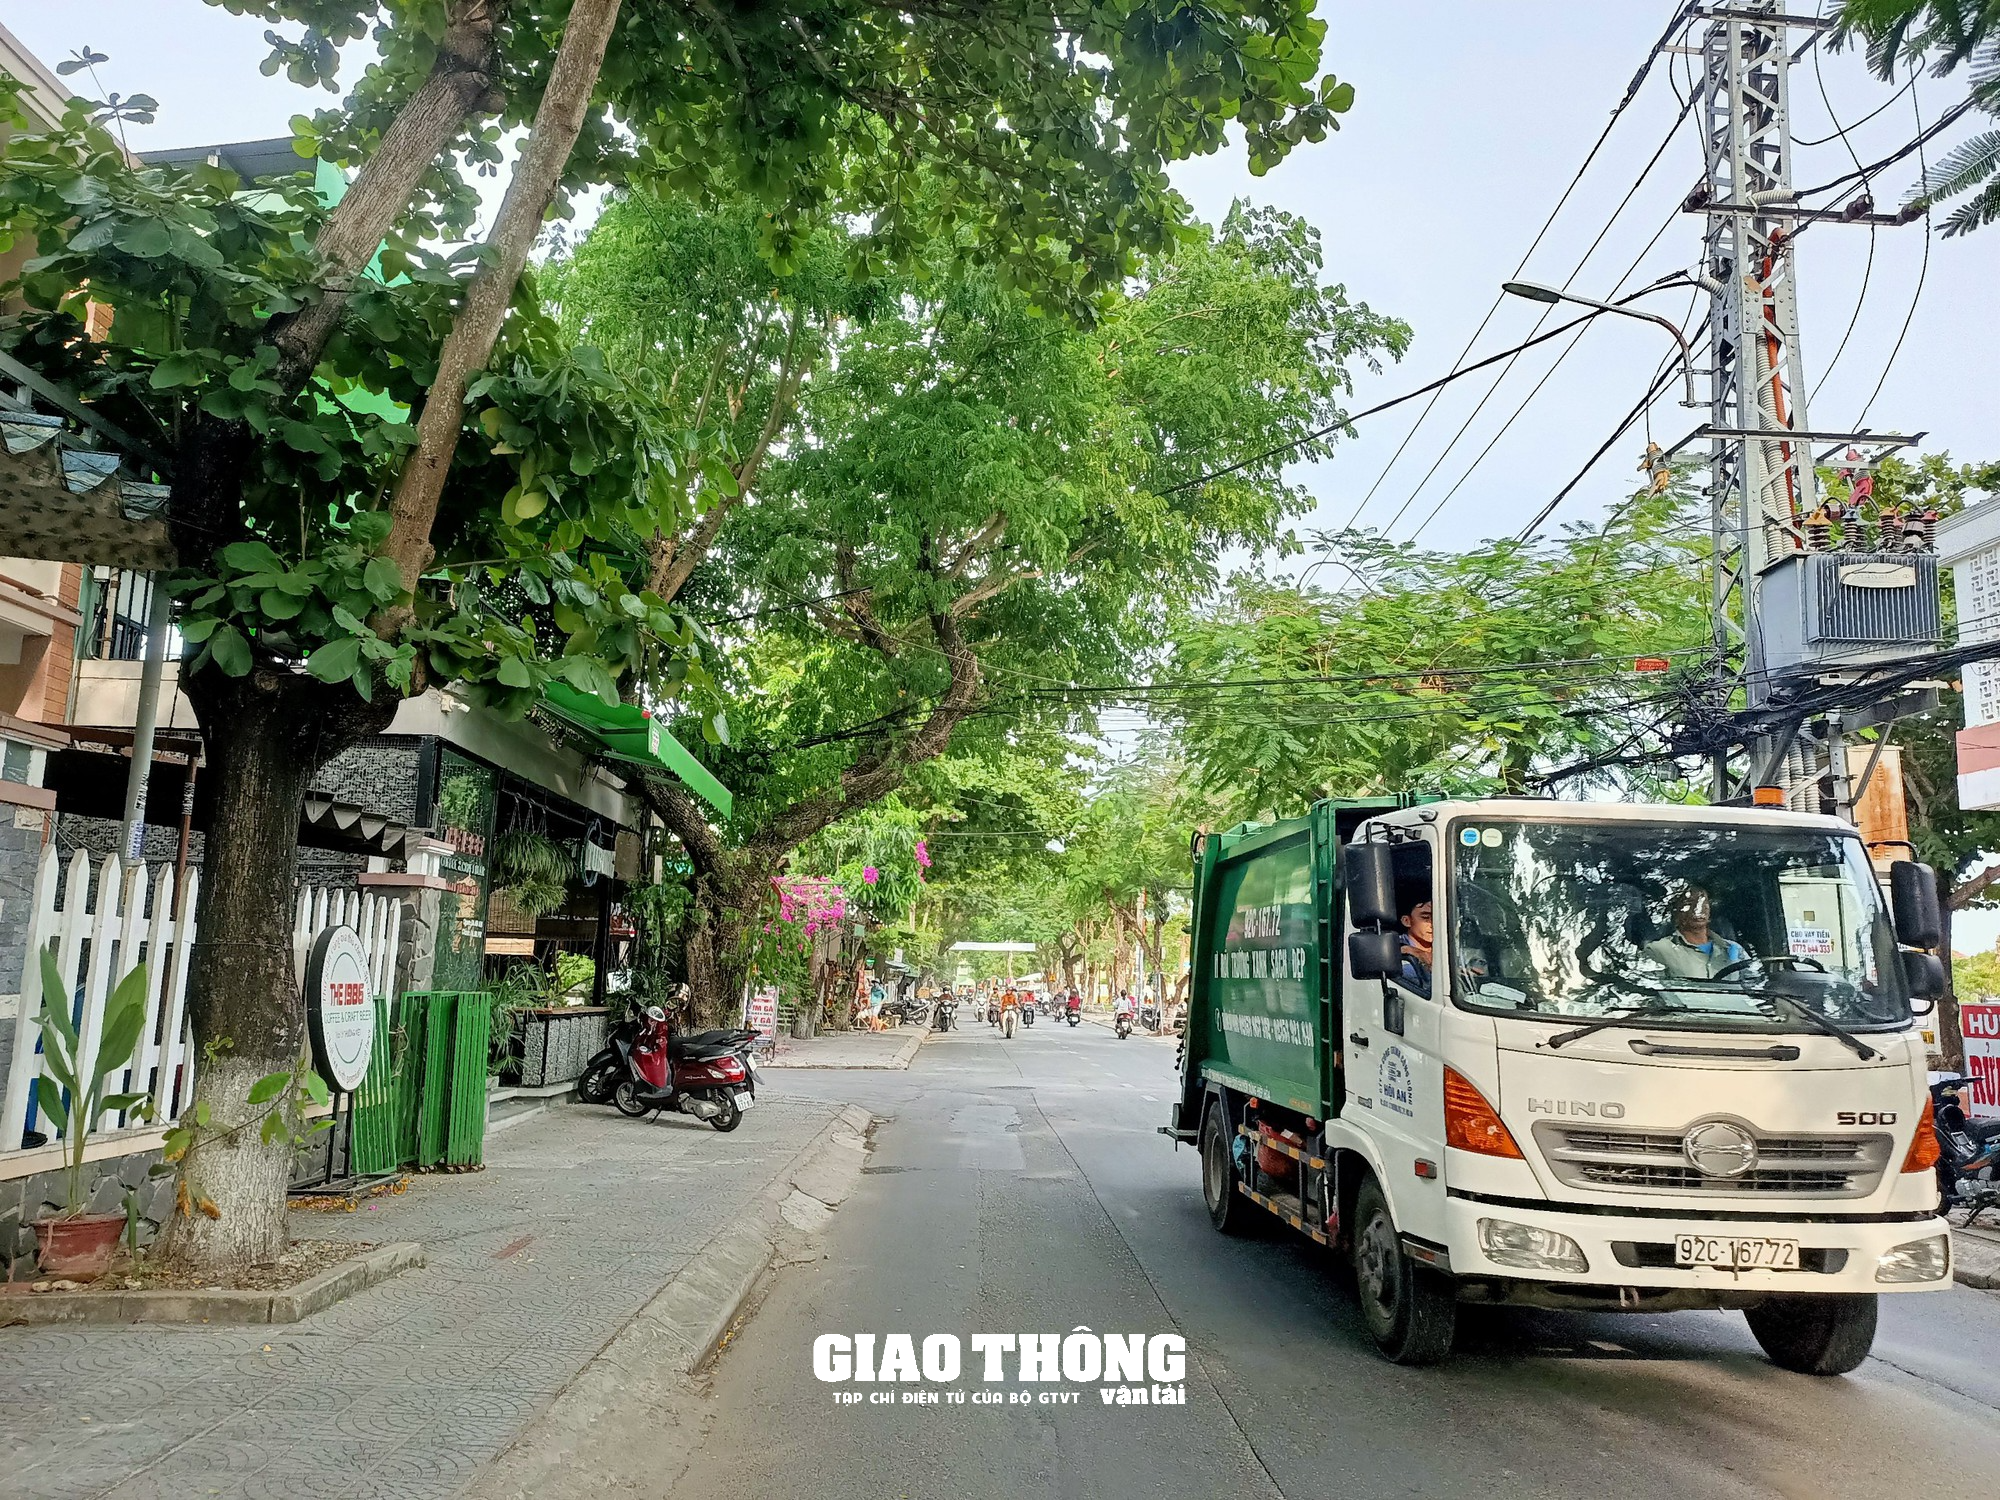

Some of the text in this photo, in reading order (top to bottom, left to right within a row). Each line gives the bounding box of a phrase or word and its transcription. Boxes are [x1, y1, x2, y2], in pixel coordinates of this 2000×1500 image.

[1244, 905, 1281, 938] 92C-167.72
[1792, 944, 1806, 953] 0773
[1819, 945, 1830, 954] 333
[1252, 950, 1267, 978] XANH
[1271, 949, 1288, 982] SẠCH
[1292, 948, 1305, 982] ĐẸP
[330, 983, 343, 1006] THE
[324, 1012, 341, 1024] COFFEE
[345, 1010, 359, 1022] CRAFT
[360, 1009, 372, 1020] BEER
[1968, 1007, 2000, 1036] HÙ
[1969, 1041, 2000, 1107] RỬ
[1396, 1089, 1407, 1103] AN
[1528, 1098, 1625, 1119] HINO
[1837, 1111, 1897, 1126] 500
